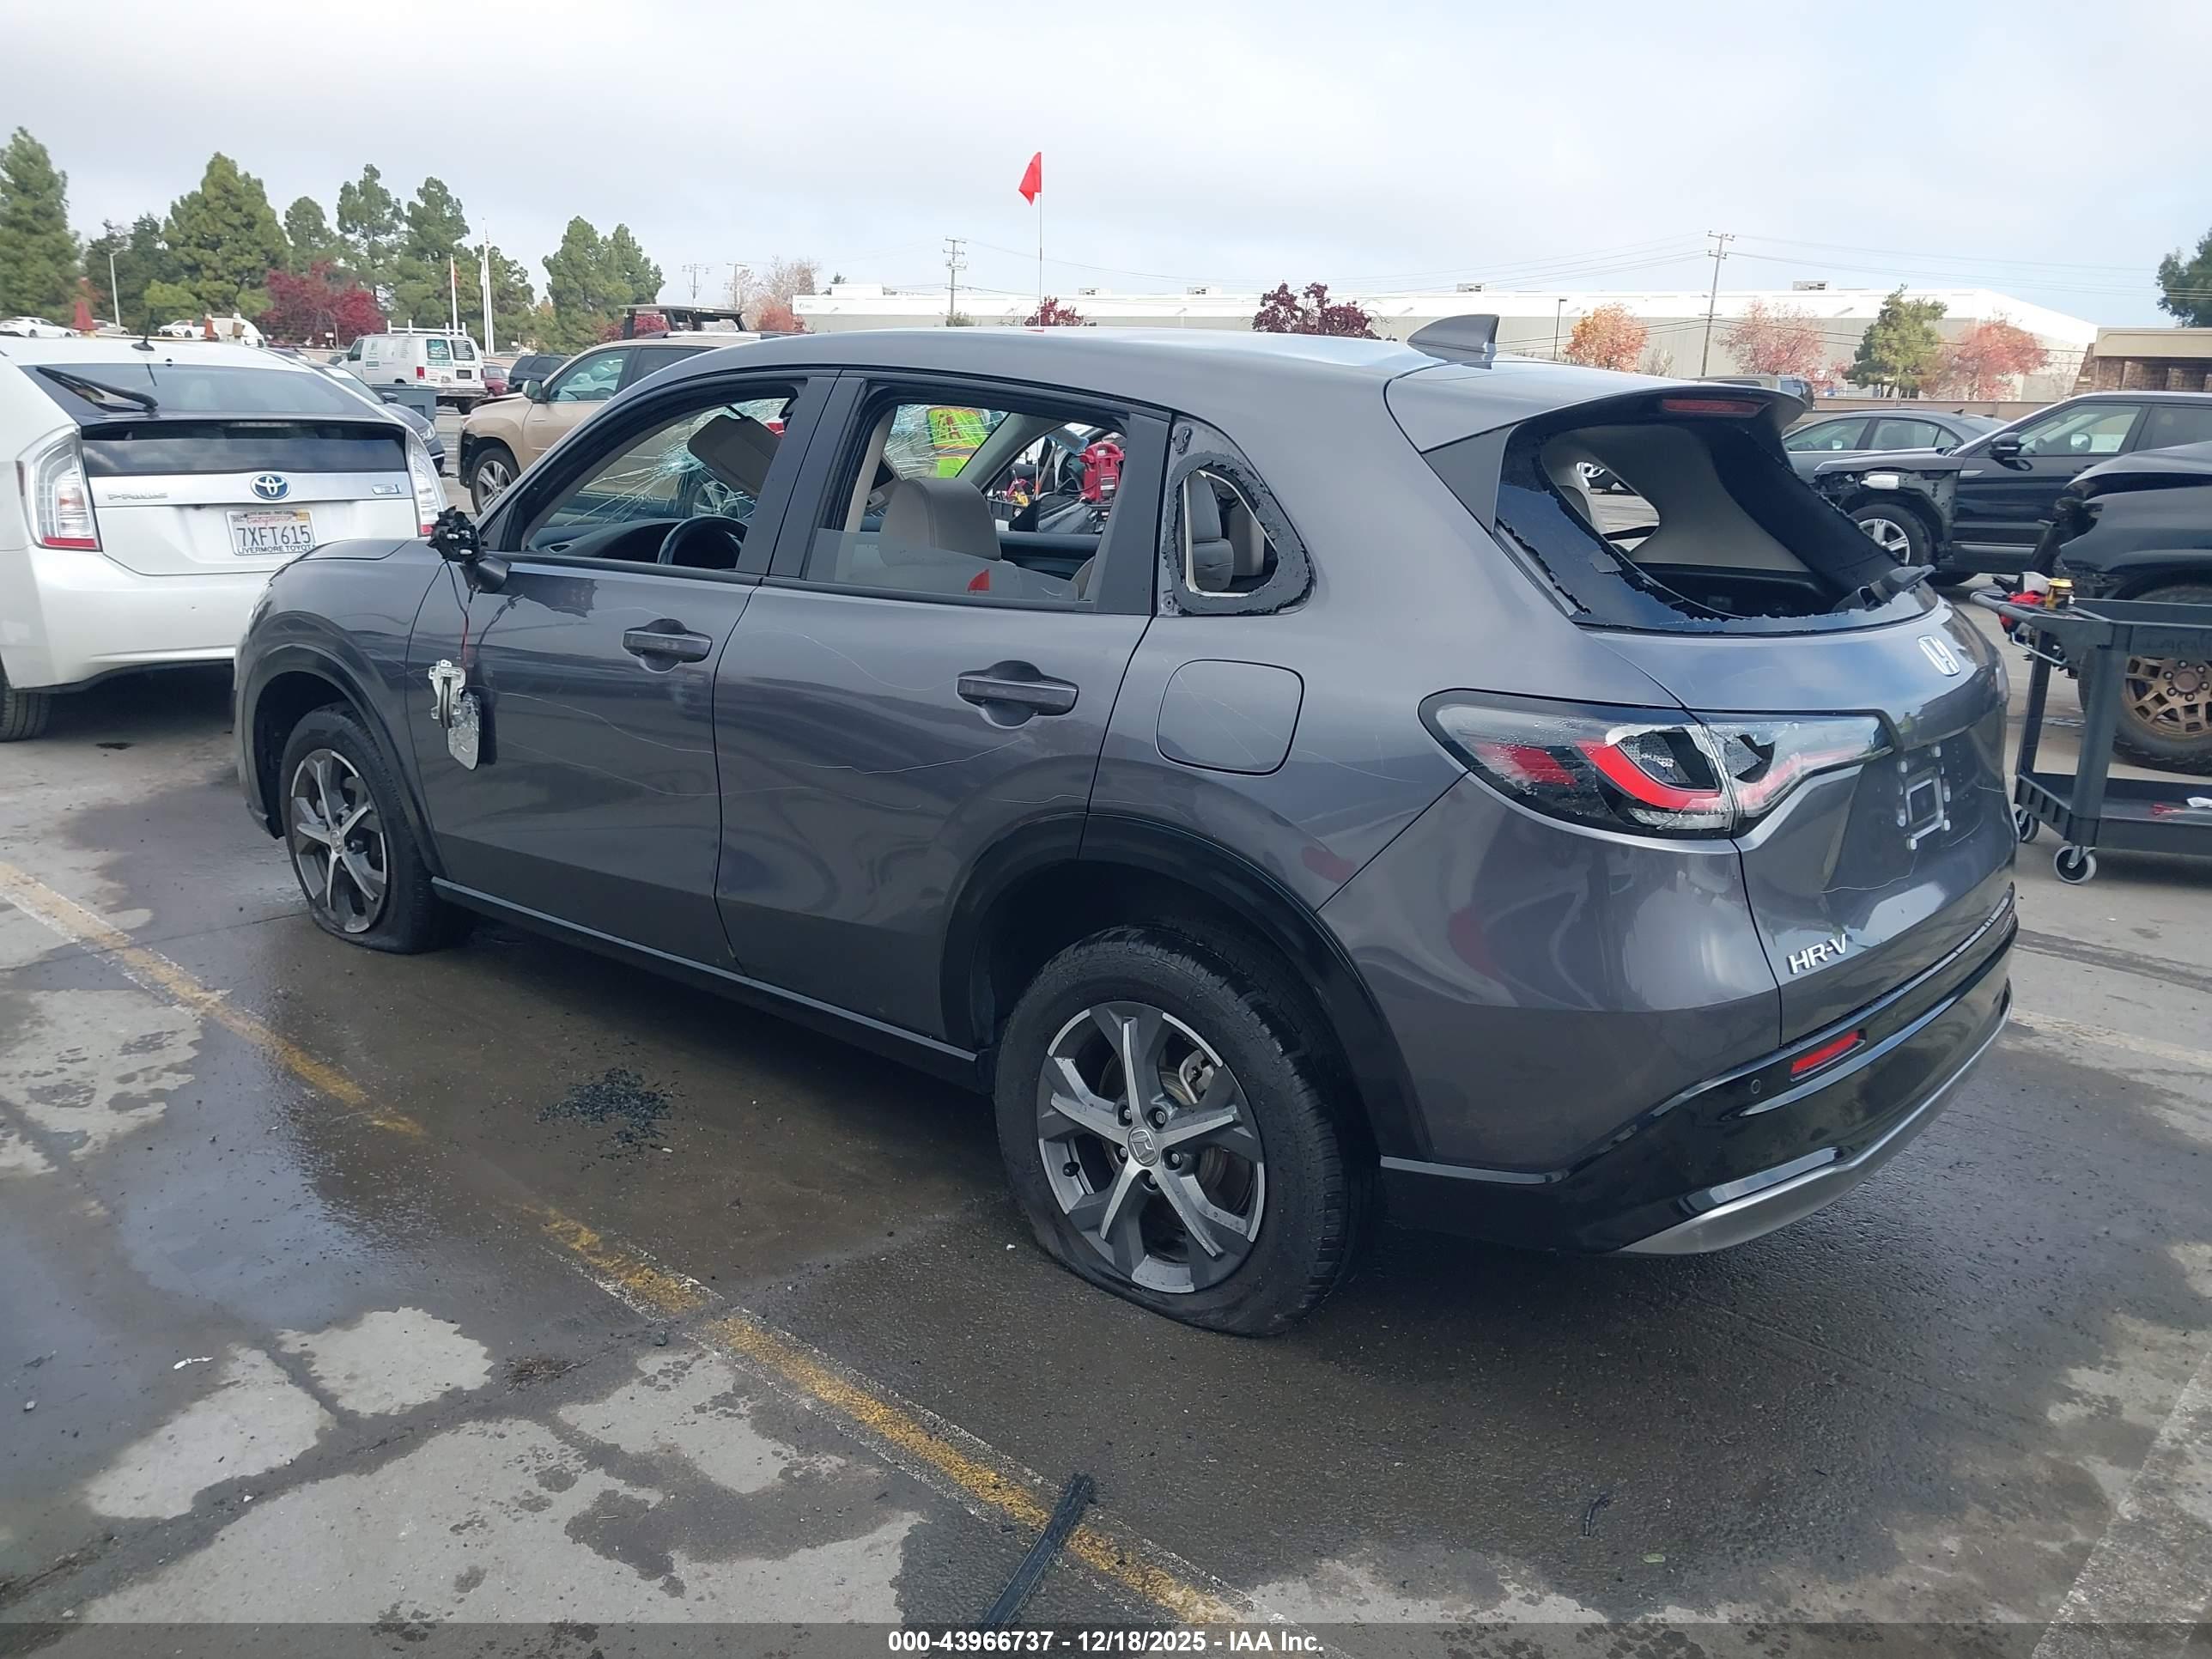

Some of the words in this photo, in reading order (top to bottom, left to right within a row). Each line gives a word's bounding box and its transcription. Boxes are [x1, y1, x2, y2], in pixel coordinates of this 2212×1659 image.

[236, 526, 311, 546] 7XFT615
[237, 544, 284, 554] LIVERMORE
[1789, 933, 1846, 974] HR-V
